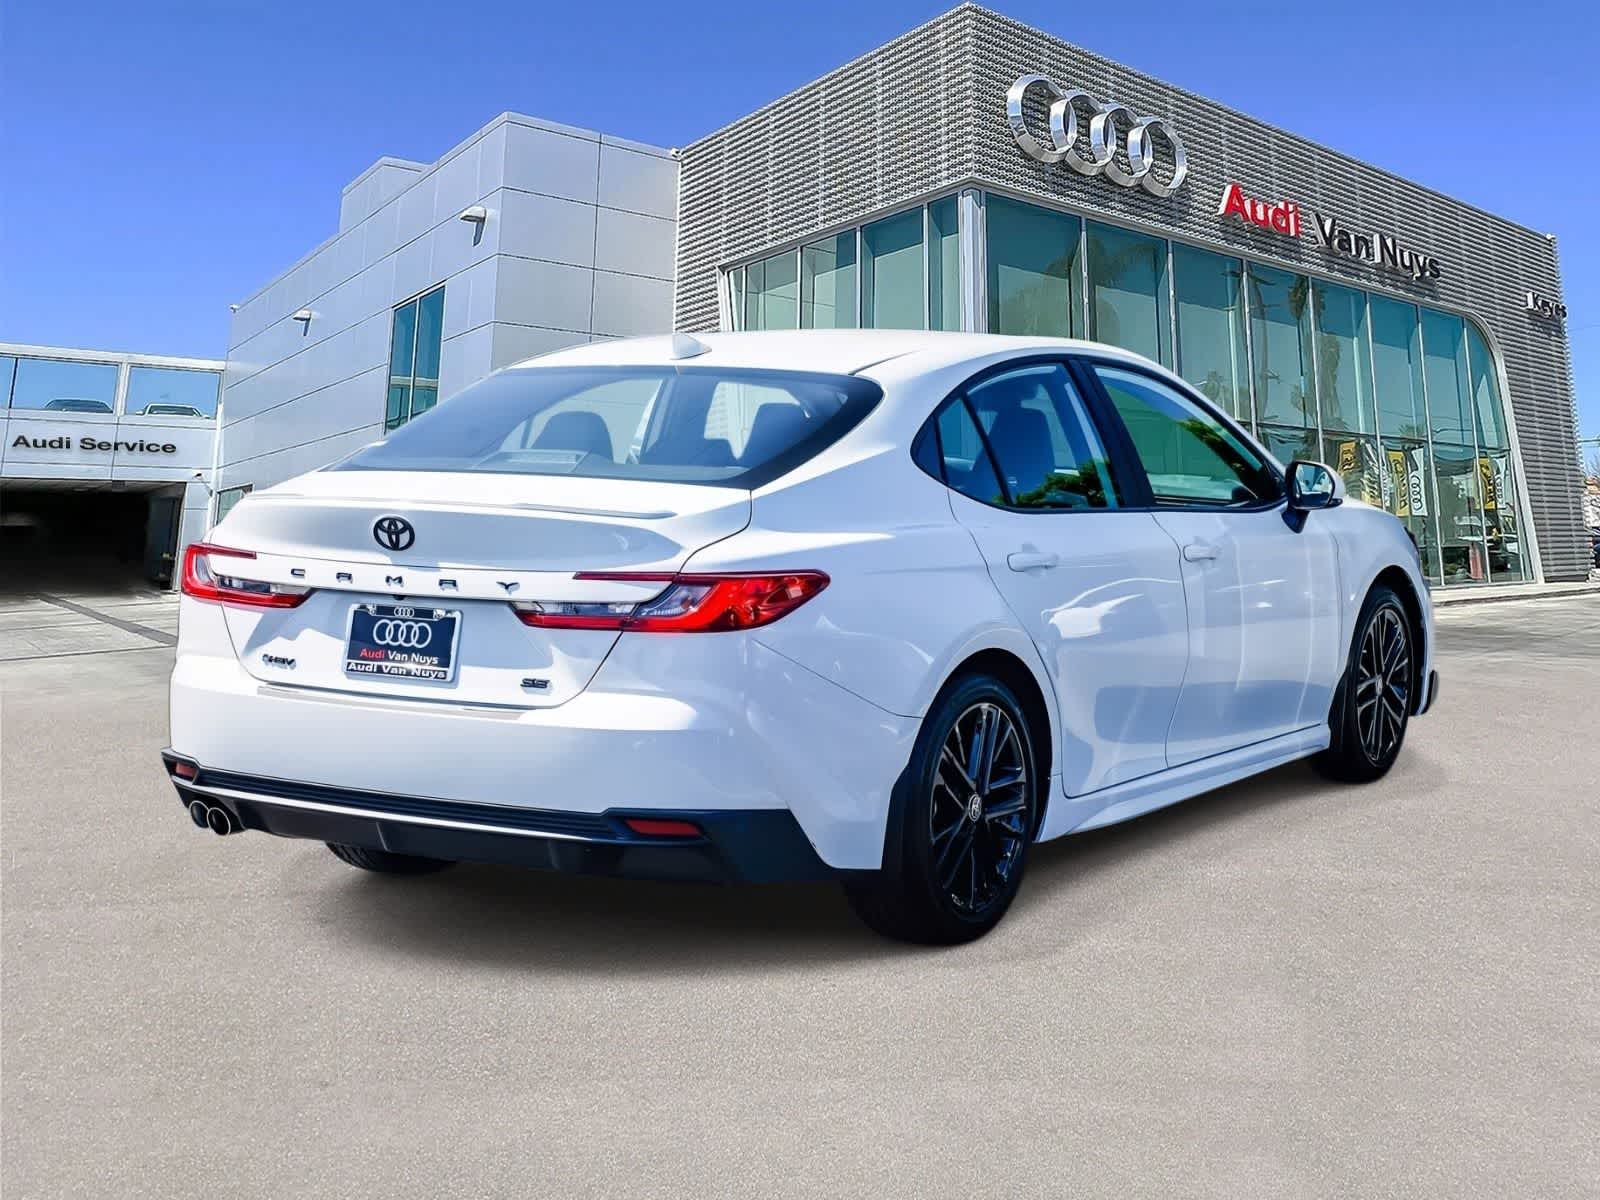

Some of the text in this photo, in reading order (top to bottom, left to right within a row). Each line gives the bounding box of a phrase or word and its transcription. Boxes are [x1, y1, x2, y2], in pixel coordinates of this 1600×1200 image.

[1218, 183, 1441, 280] Audi Van Nuys
[1526, 291, 1568, 319] Keyes
[12, 435, 177, 454] Audi Service
[290, 567, 518, 594] CAMRY
[360, 647, 439, 666] Audi Van Nuys
[347, 661, 446, 679] Audi Van Nuys
